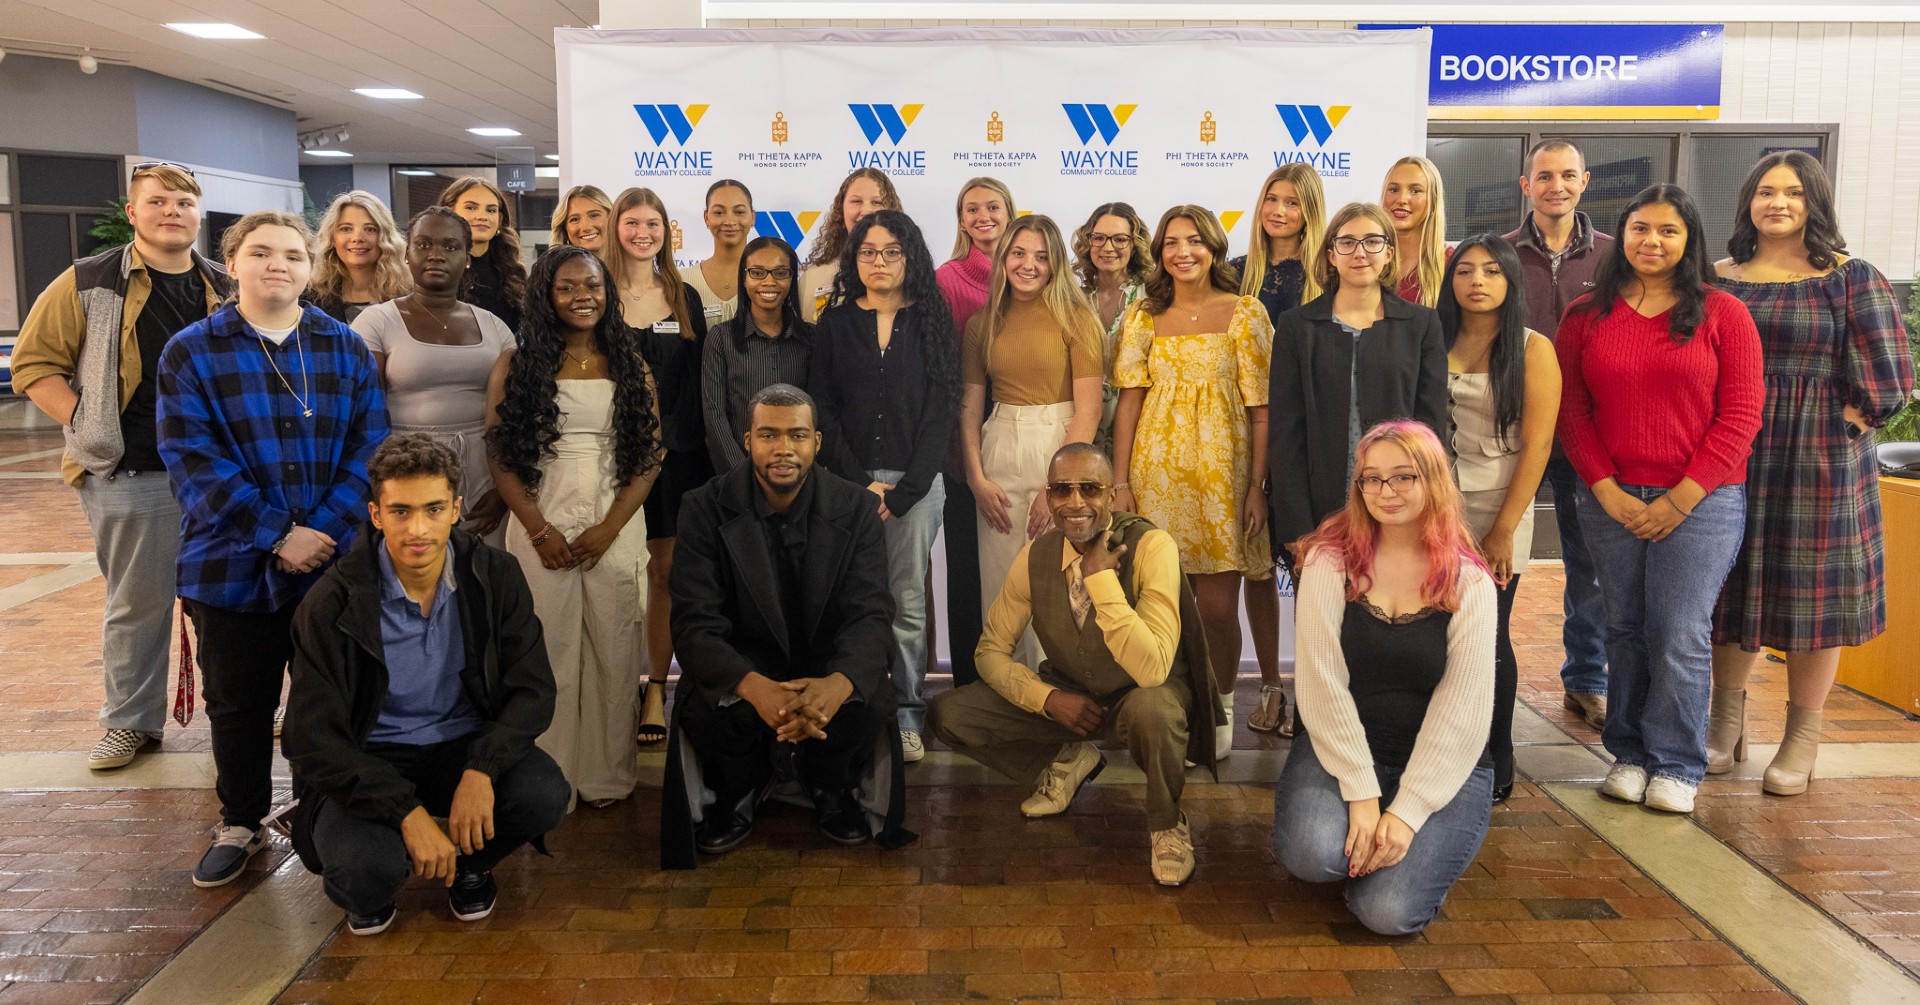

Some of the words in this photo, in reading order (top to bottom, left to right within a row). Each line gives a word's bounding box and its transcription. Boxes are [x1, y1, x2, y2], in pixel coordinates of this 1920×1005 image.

[1439, 54, 1638, 81] BOOKSTORE
[634, 151, 713, 169] WAYNE
[738, 152, 755, 161] PHI
[758, 152, 791, 161] THETA
[793, 152, 823, 161] KAPPA
[848, 150, 926, 168] WAYNE
[953, 152, 969, 160] PHI
[973, 152, 1005, 160] THETA
[1007, 152, 1037, 160] KAPPA
[1060, 150, 1139, 168] WAYNE
[1165, 152, 1182, 160] PHI
[1185, 152, 1218, 160] THETA
[1220, 152, 1250, 160] KAPPA
[1273, 151, 1351, 170] WAYNE
[634, 169, 677, 177] COMMUNITY
[678, 169, 712, 177] COLLEGE
[891, 168, 925, 176] COLLEGE
[1060, 168, 1103, 176] COMMUNITY
[1104, 168, 1137, 176] COLLEGE
